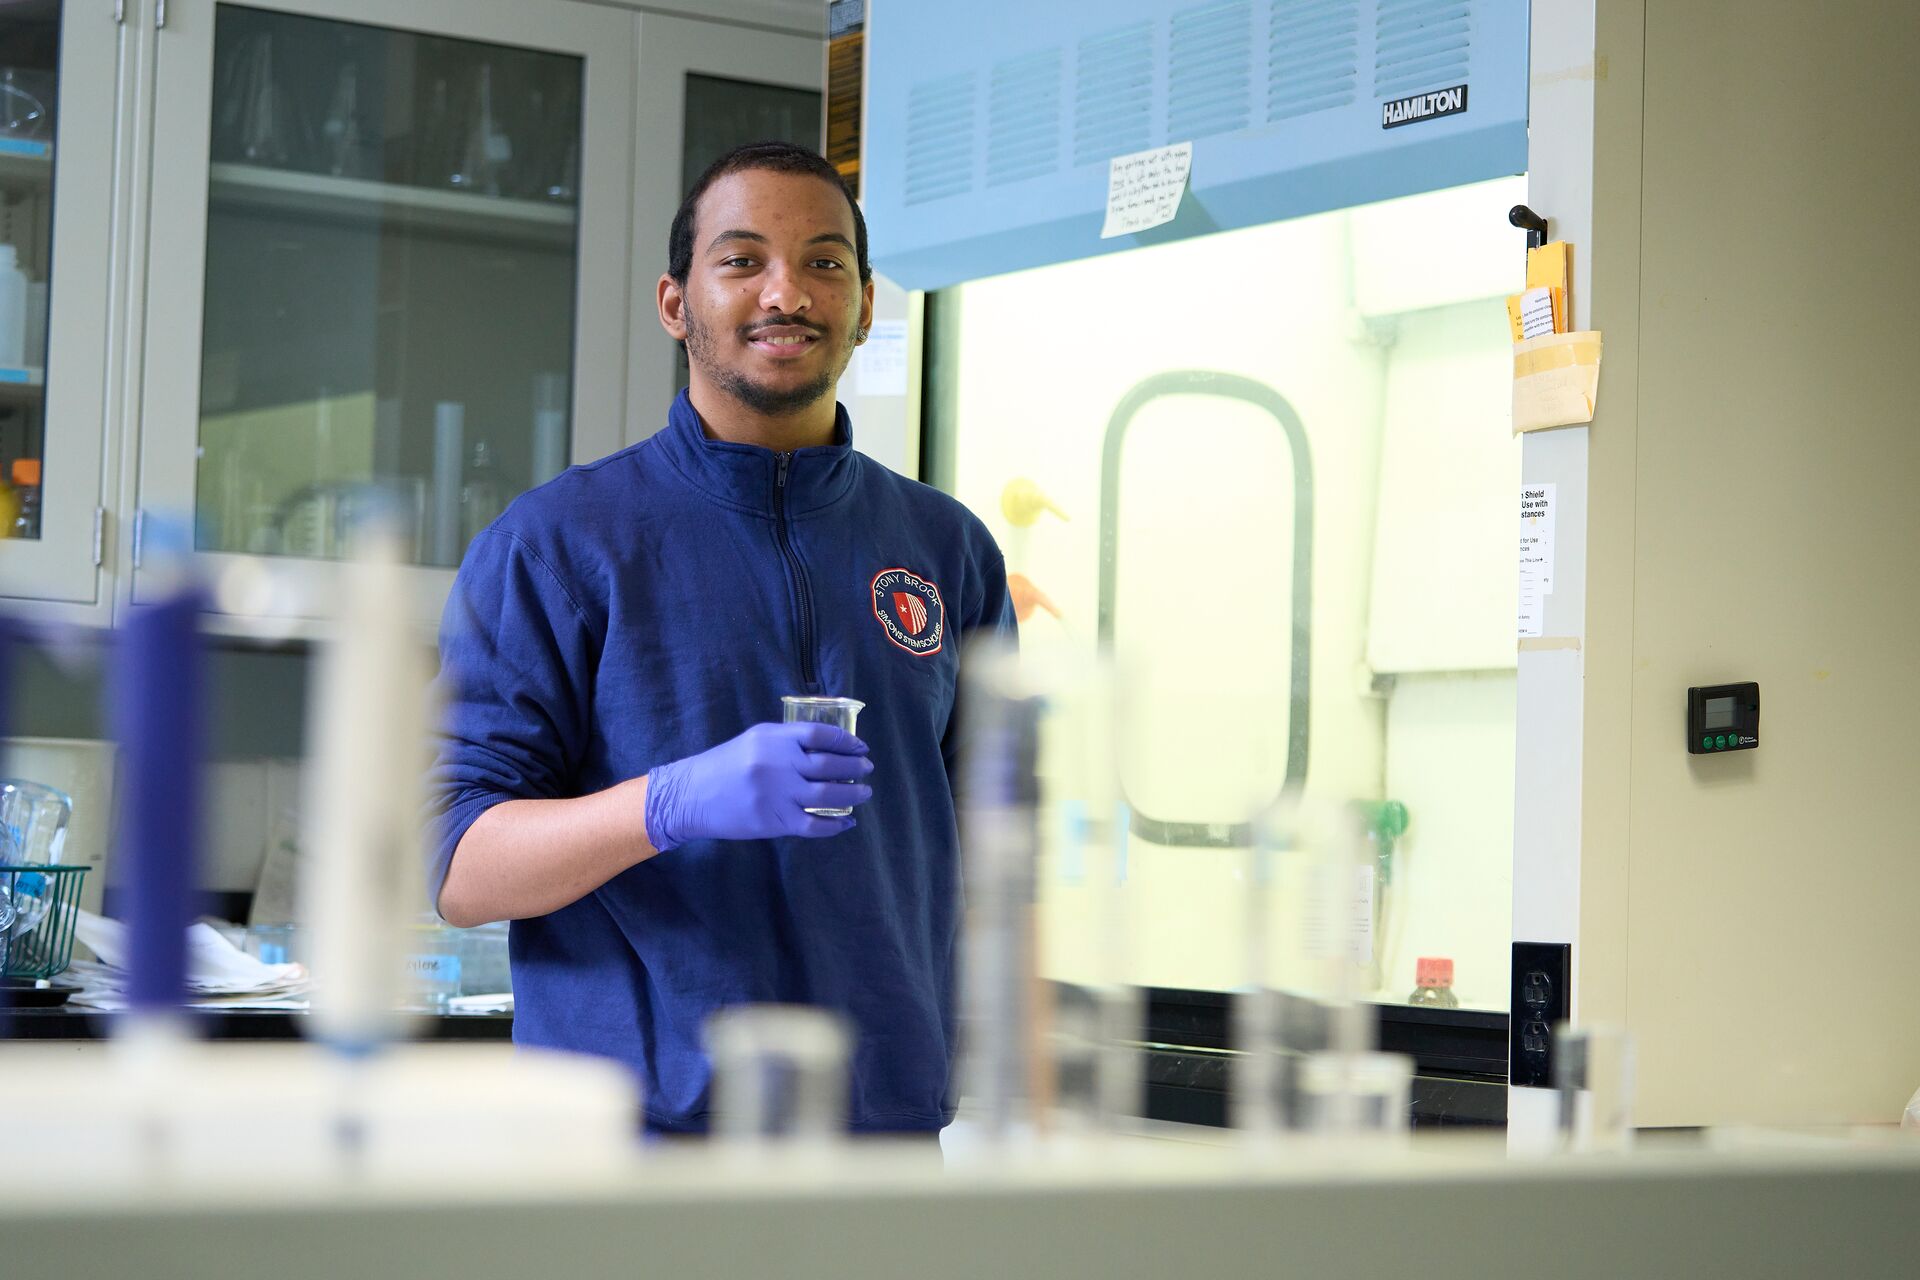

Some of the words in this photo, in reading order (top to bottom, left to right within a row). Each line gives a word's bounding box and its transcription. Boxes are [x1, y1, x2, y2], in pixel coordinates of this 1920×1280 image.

[1383, 87, 1462, 125] HAMILTON
[1521, 500, 1534, 509] Use
[1535, 500, 1549, 508] with
[1525, 490, 1545, 499] Shield
[875, 574, 900, 598] STONY
[904, 575, 940, 607] BROOK
[878, 610, 904, 639] SIMONS
